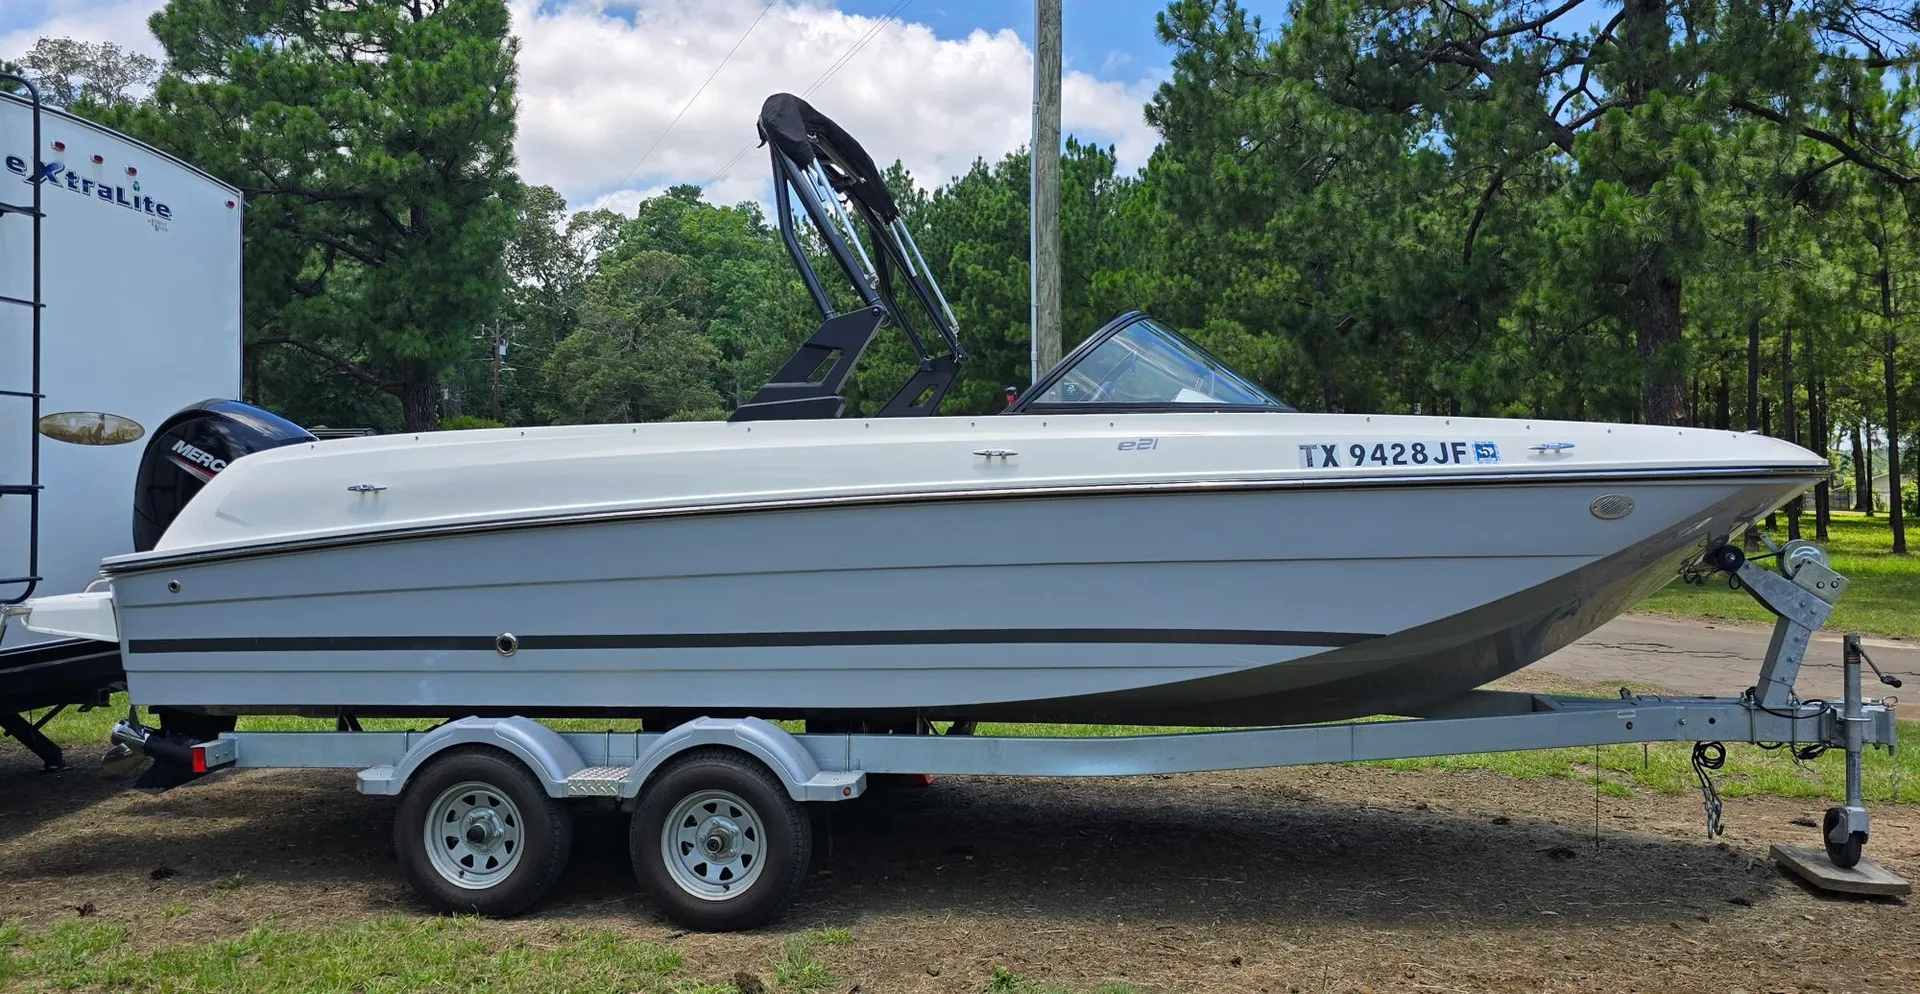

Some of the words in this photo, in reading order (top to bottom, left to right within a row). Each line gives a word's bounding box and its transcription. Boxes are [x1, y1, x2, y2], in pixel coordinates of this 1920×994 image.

[1299, 444, 1340, 468] TX
[1349, 442, 1429, 467] 9428
[1433, 442, 1467, 465] JF
